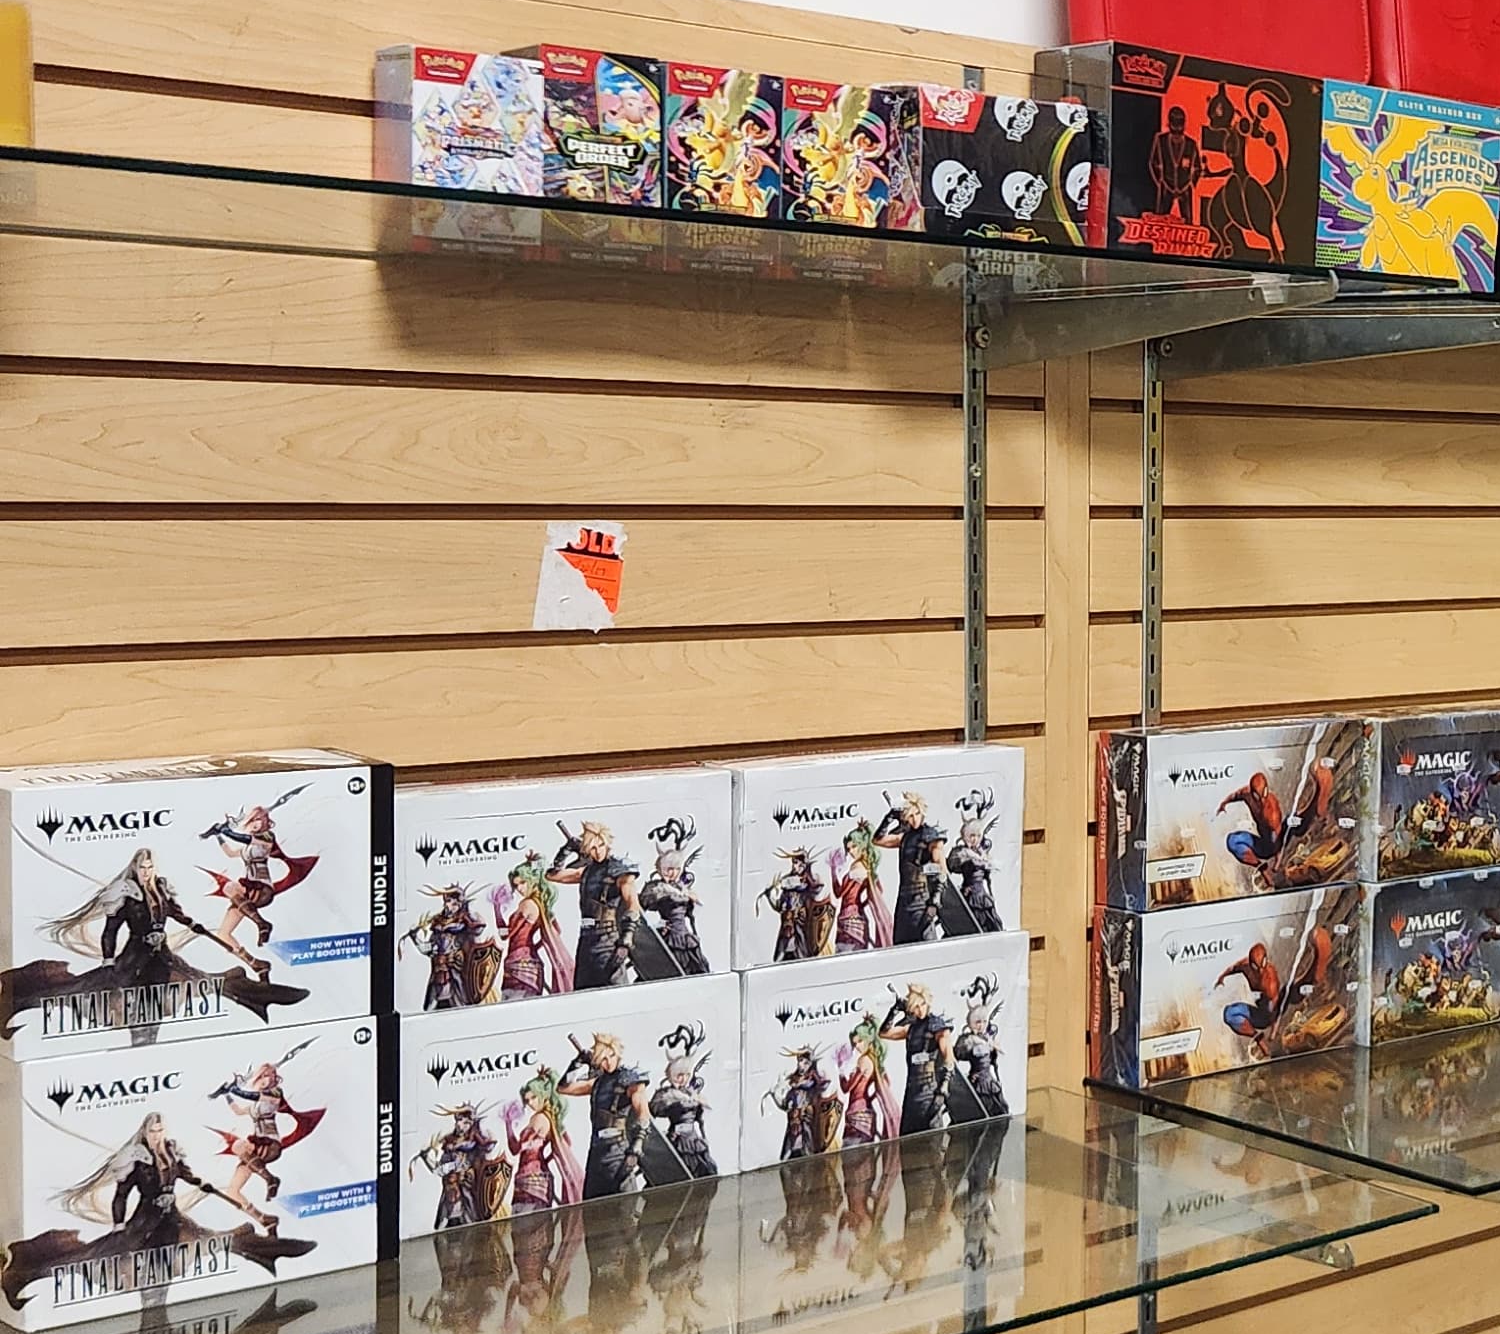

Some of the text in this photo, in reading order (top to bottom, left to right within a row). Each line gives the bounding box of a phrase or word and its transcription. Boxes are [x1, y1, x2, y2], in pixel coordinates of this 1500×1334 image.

[566, 137, 637, 157] PERFECT
[575, 152, 630, 168] ORDER
[1414, 144, 1496, 180] ASCENDED
[1421, 167, 1483, 190] HEROES
[1128, 223, 1208, 244] DESTINED
[1415, 750, 1472, 771] MAGIC
[1182, 765, 1234, 783] MAGIC
[64, 809, 175, 835] MAGIC
[790, 803, 860, 825] MAGIC
[86, 832, 137, 842] GATHERING
[439, 834, 528, 858] MAGIC
[374, 854, 388, 926] BUNDLE
[1405, 909, 1465, 933] MAGIC
[310, 942, 332, 950] NOW
[334, 938, 358, 948] WITH
[1180, 938, 1233, 959] MAGIC
[292, 951, 314, 961] PLAY
[40, 976, 226, 1035] FINAL FANTASY
[450, 1049, 539, 1078] MAGIC
[75, 1070, 184, 1104] MAGIC
[96, 1097, 146, 1109] GATHERING
[380, 1102, 393, 1174] BUNDLE
[317, 1191, 339, 1202] NOW
[341, 1187, 364, 1198] WITH
[51, 1234, 234, 1304] FINAL FANTASY
